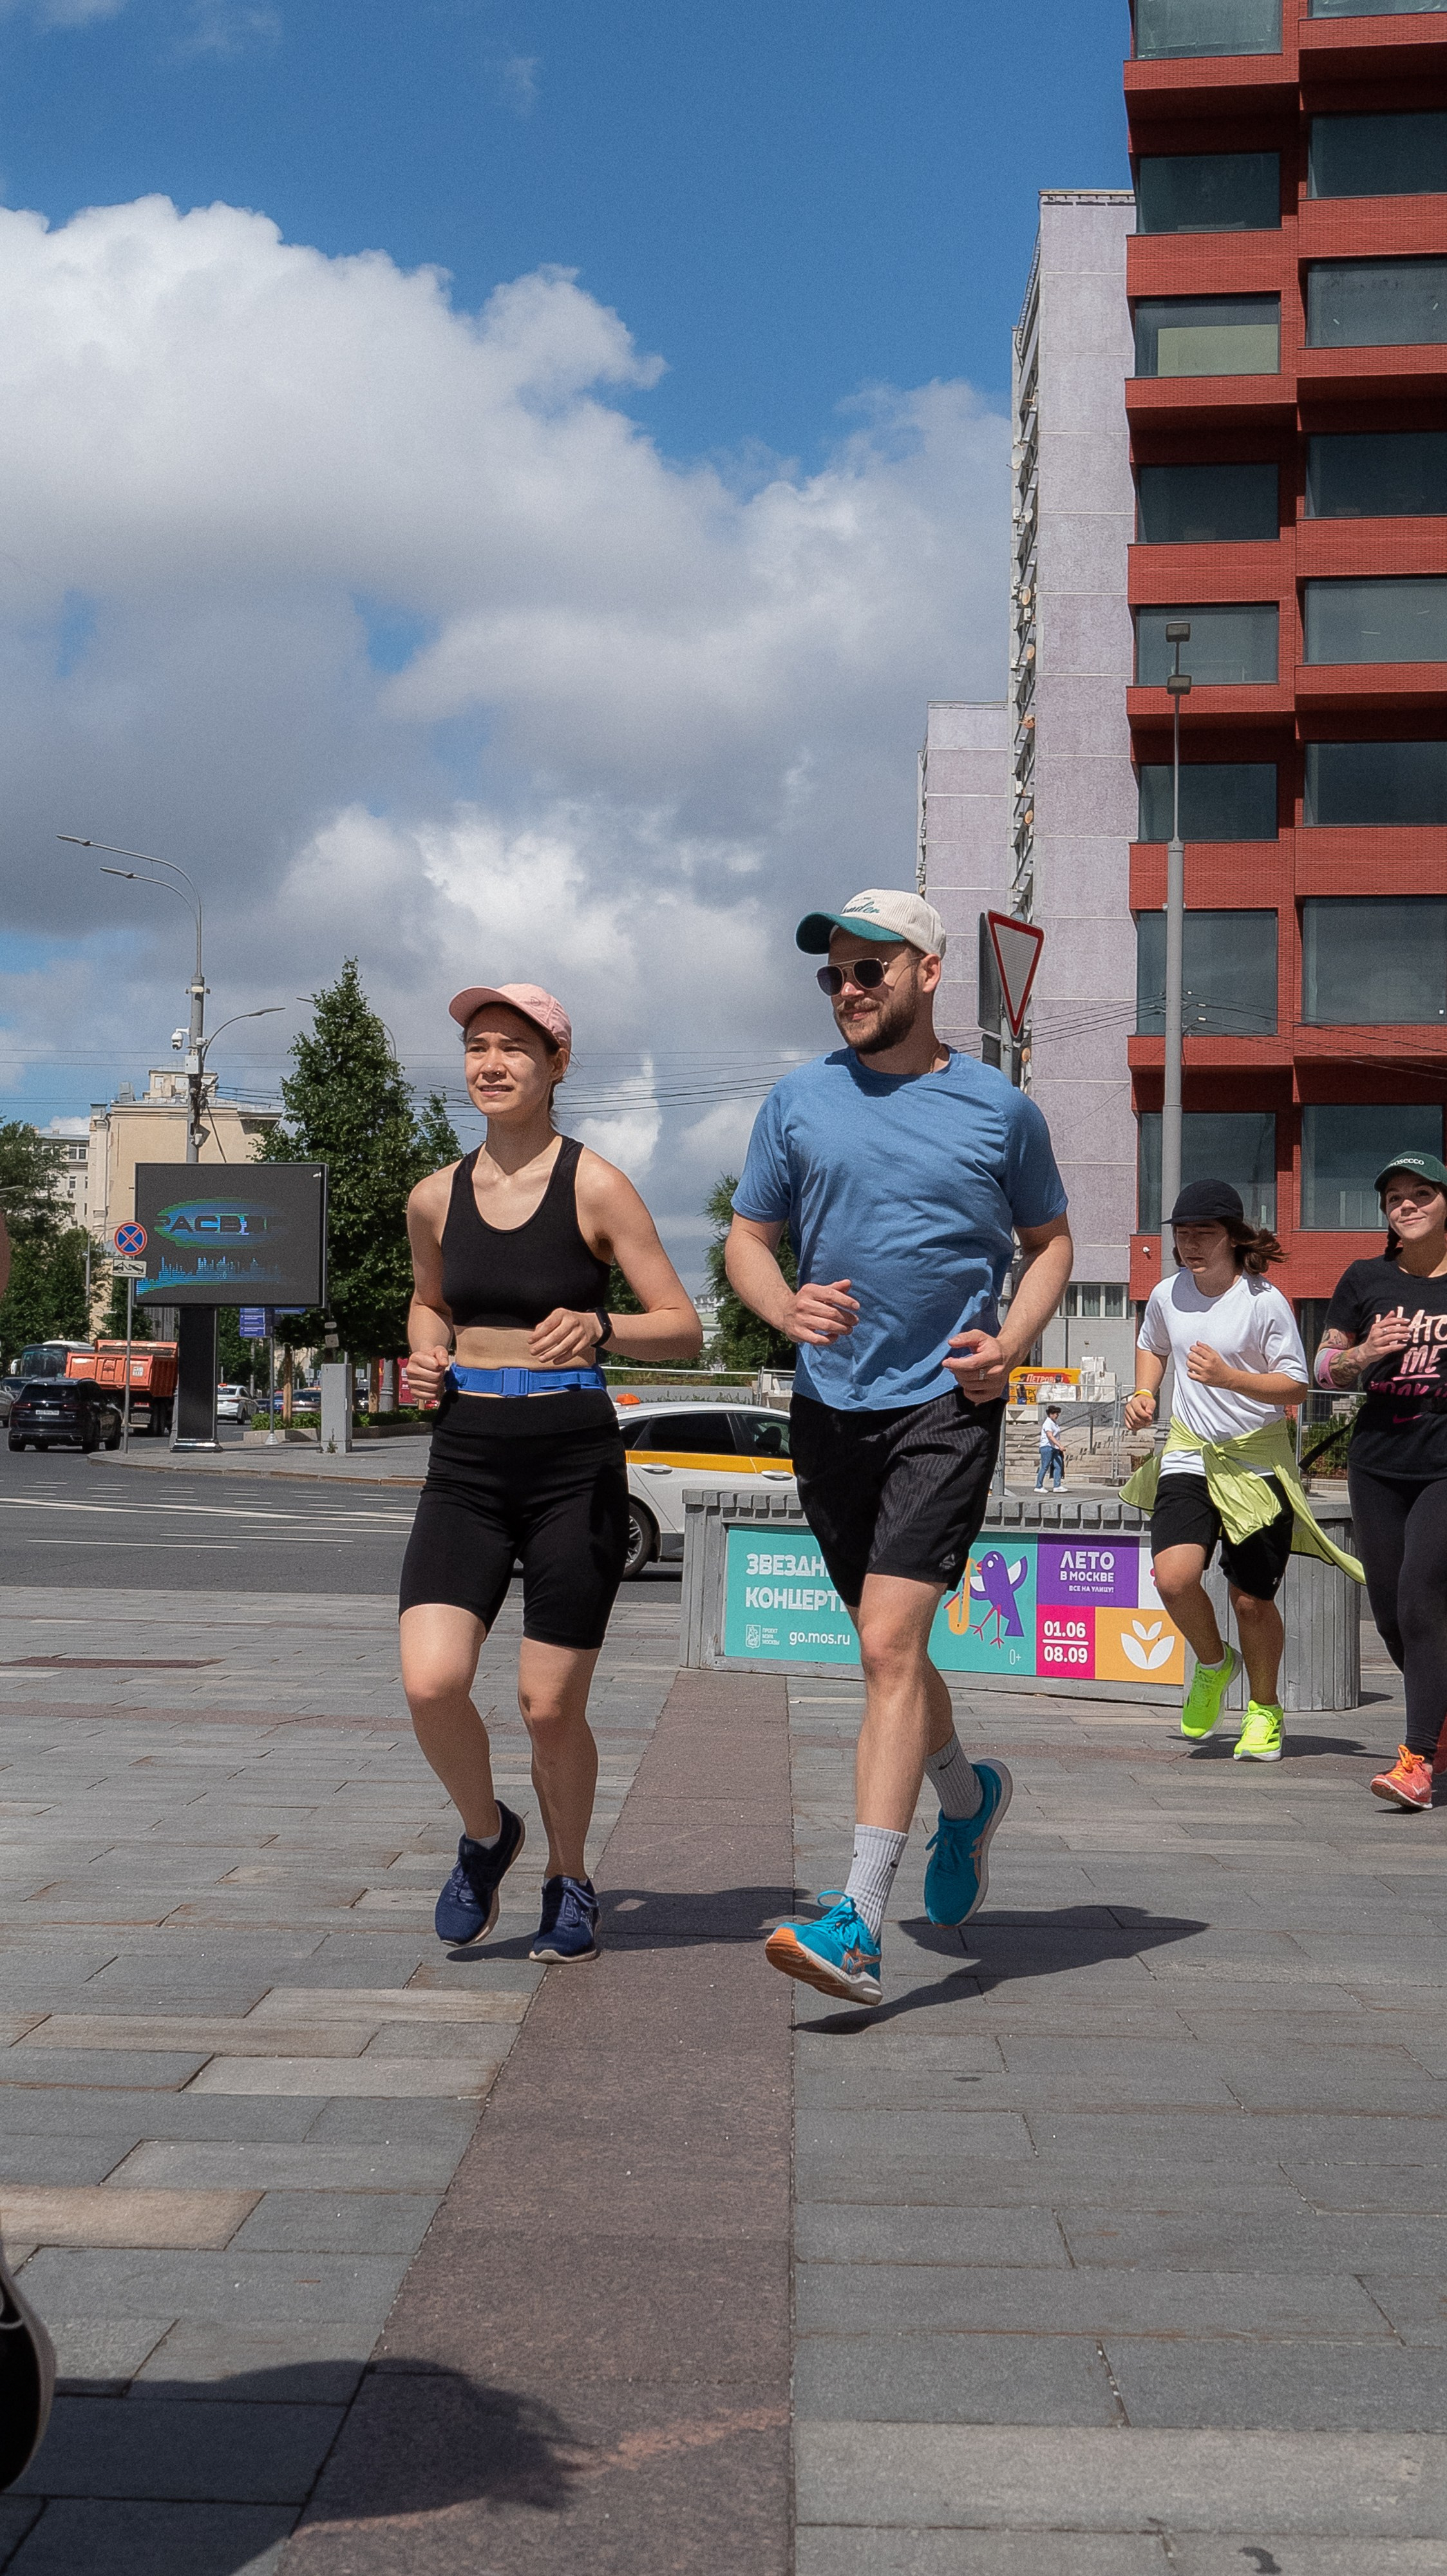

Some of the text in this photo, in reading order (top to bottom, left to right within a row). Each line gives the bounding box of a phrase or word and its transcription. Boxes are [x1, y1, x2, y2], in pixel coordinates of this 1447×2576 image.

[1400, 1345, 1447, 1374] ME
[746, 1553, 830, 1577] ЗВЕЗДН
[1060, 1551, 1115, 1570] ЛЕТО
[1060, 1571, 1114, 1582] В МОСКВЕ
[790, 1631, 850, 1645] go.mos.ru
[1044, 1620, 1086, 1638] 01.06
[1009, 1649, 1021, 1665] 0+
[1044, 1645, 1088, 1663] 08.09
